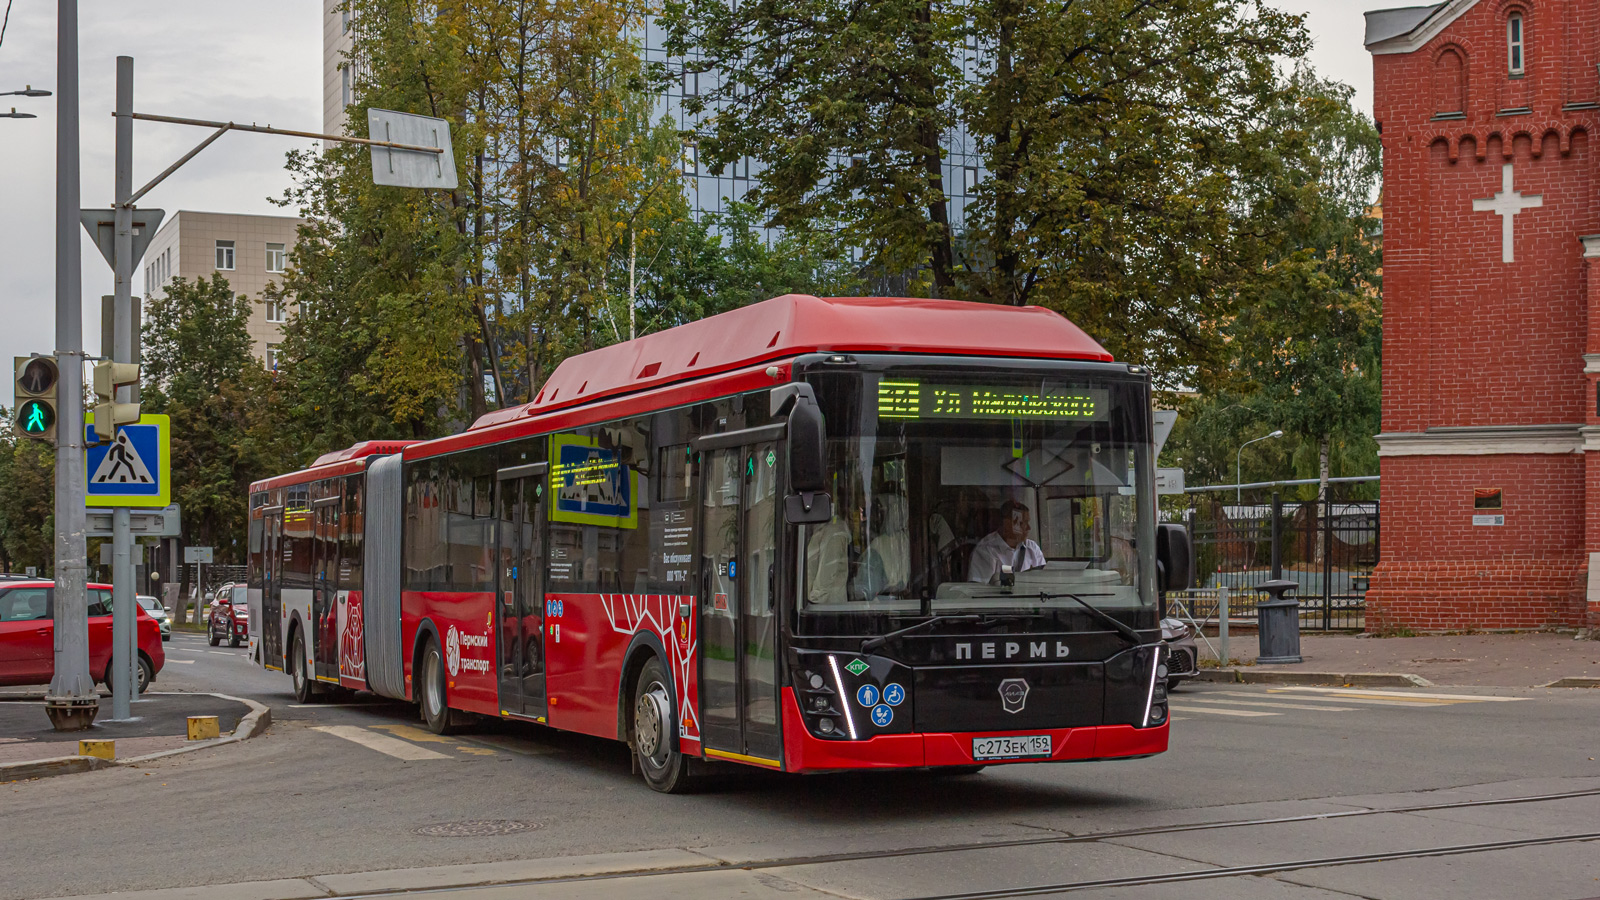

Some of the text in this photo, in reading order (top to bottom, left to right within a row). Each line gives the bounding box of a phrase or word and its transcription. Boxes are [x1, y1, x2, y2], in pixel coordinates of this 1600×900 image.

[460, 631, 488, 649] Пермский
[956, 641, 1070, 659] ПЕРМЬ
[461, 658, 489, 675] транспорт
[977, 738, 1050, 755] С273ЕК 159
